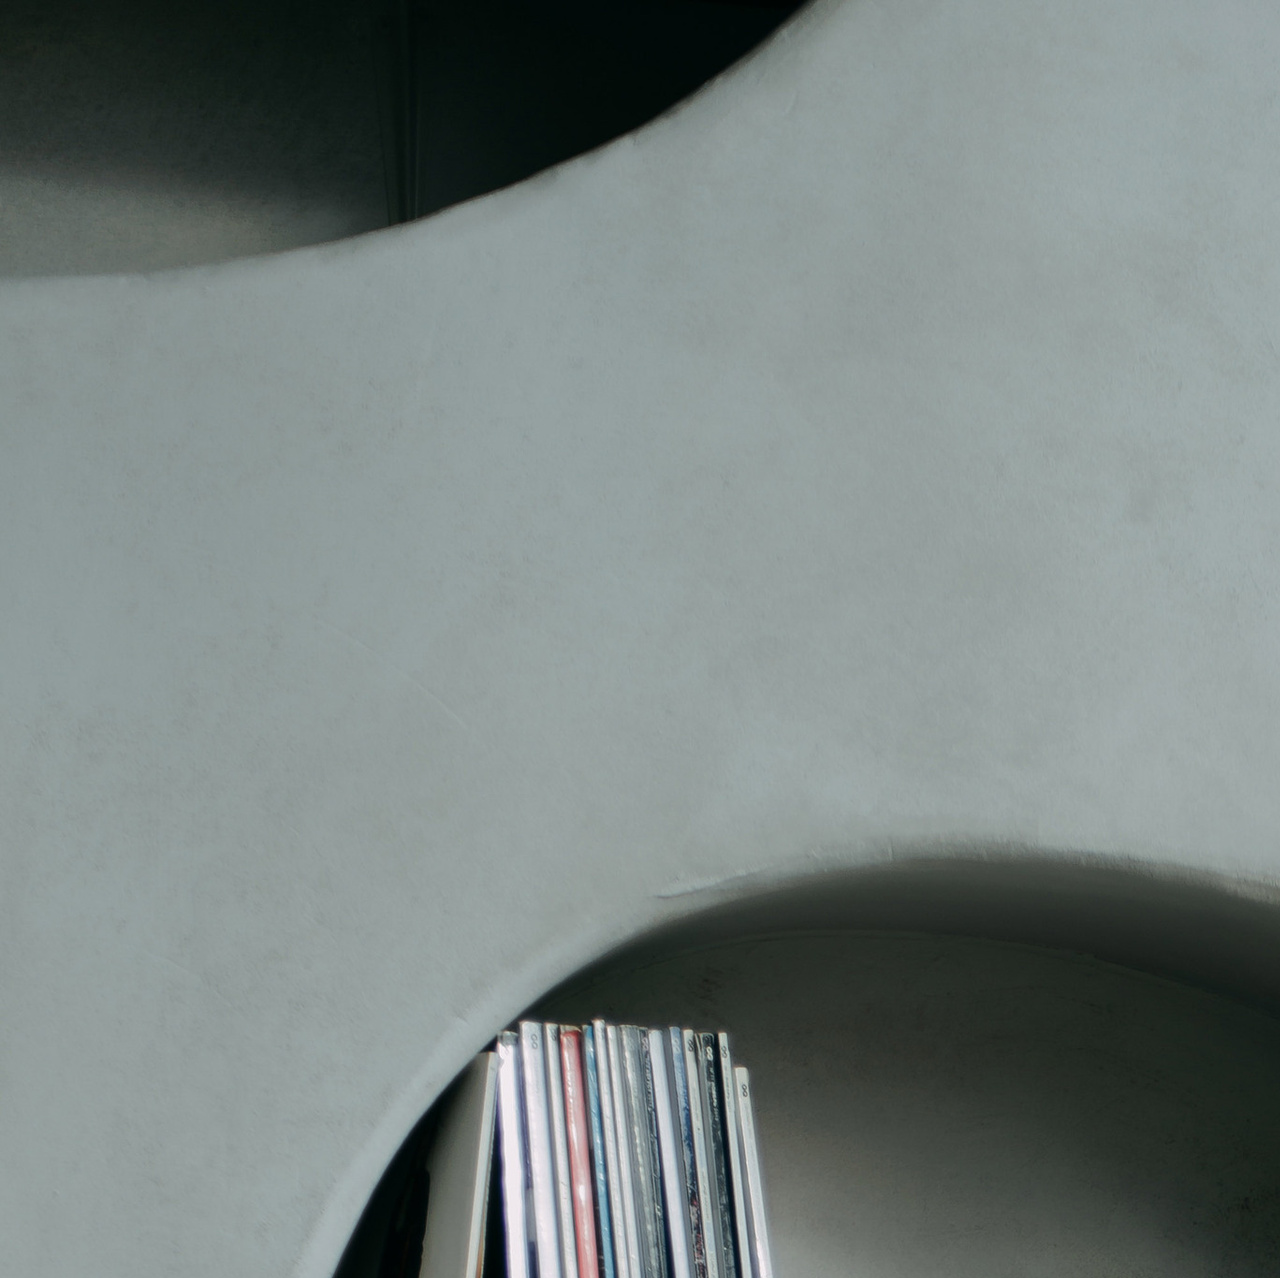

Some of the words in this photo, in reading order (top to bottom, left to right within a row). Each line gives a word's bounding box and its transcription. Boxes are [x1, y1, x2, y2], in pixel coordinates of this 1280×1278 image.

[531, 1034, 538, 1049] GQ
[641, 1037, 648, 1050] GQ
[687, 1039, 694, 1052] GQ
[706, 1046, 713, 1061] GQ
[721, 1045, 728, 1058] GQ
[741, 1084, 748, 1097] GQ
